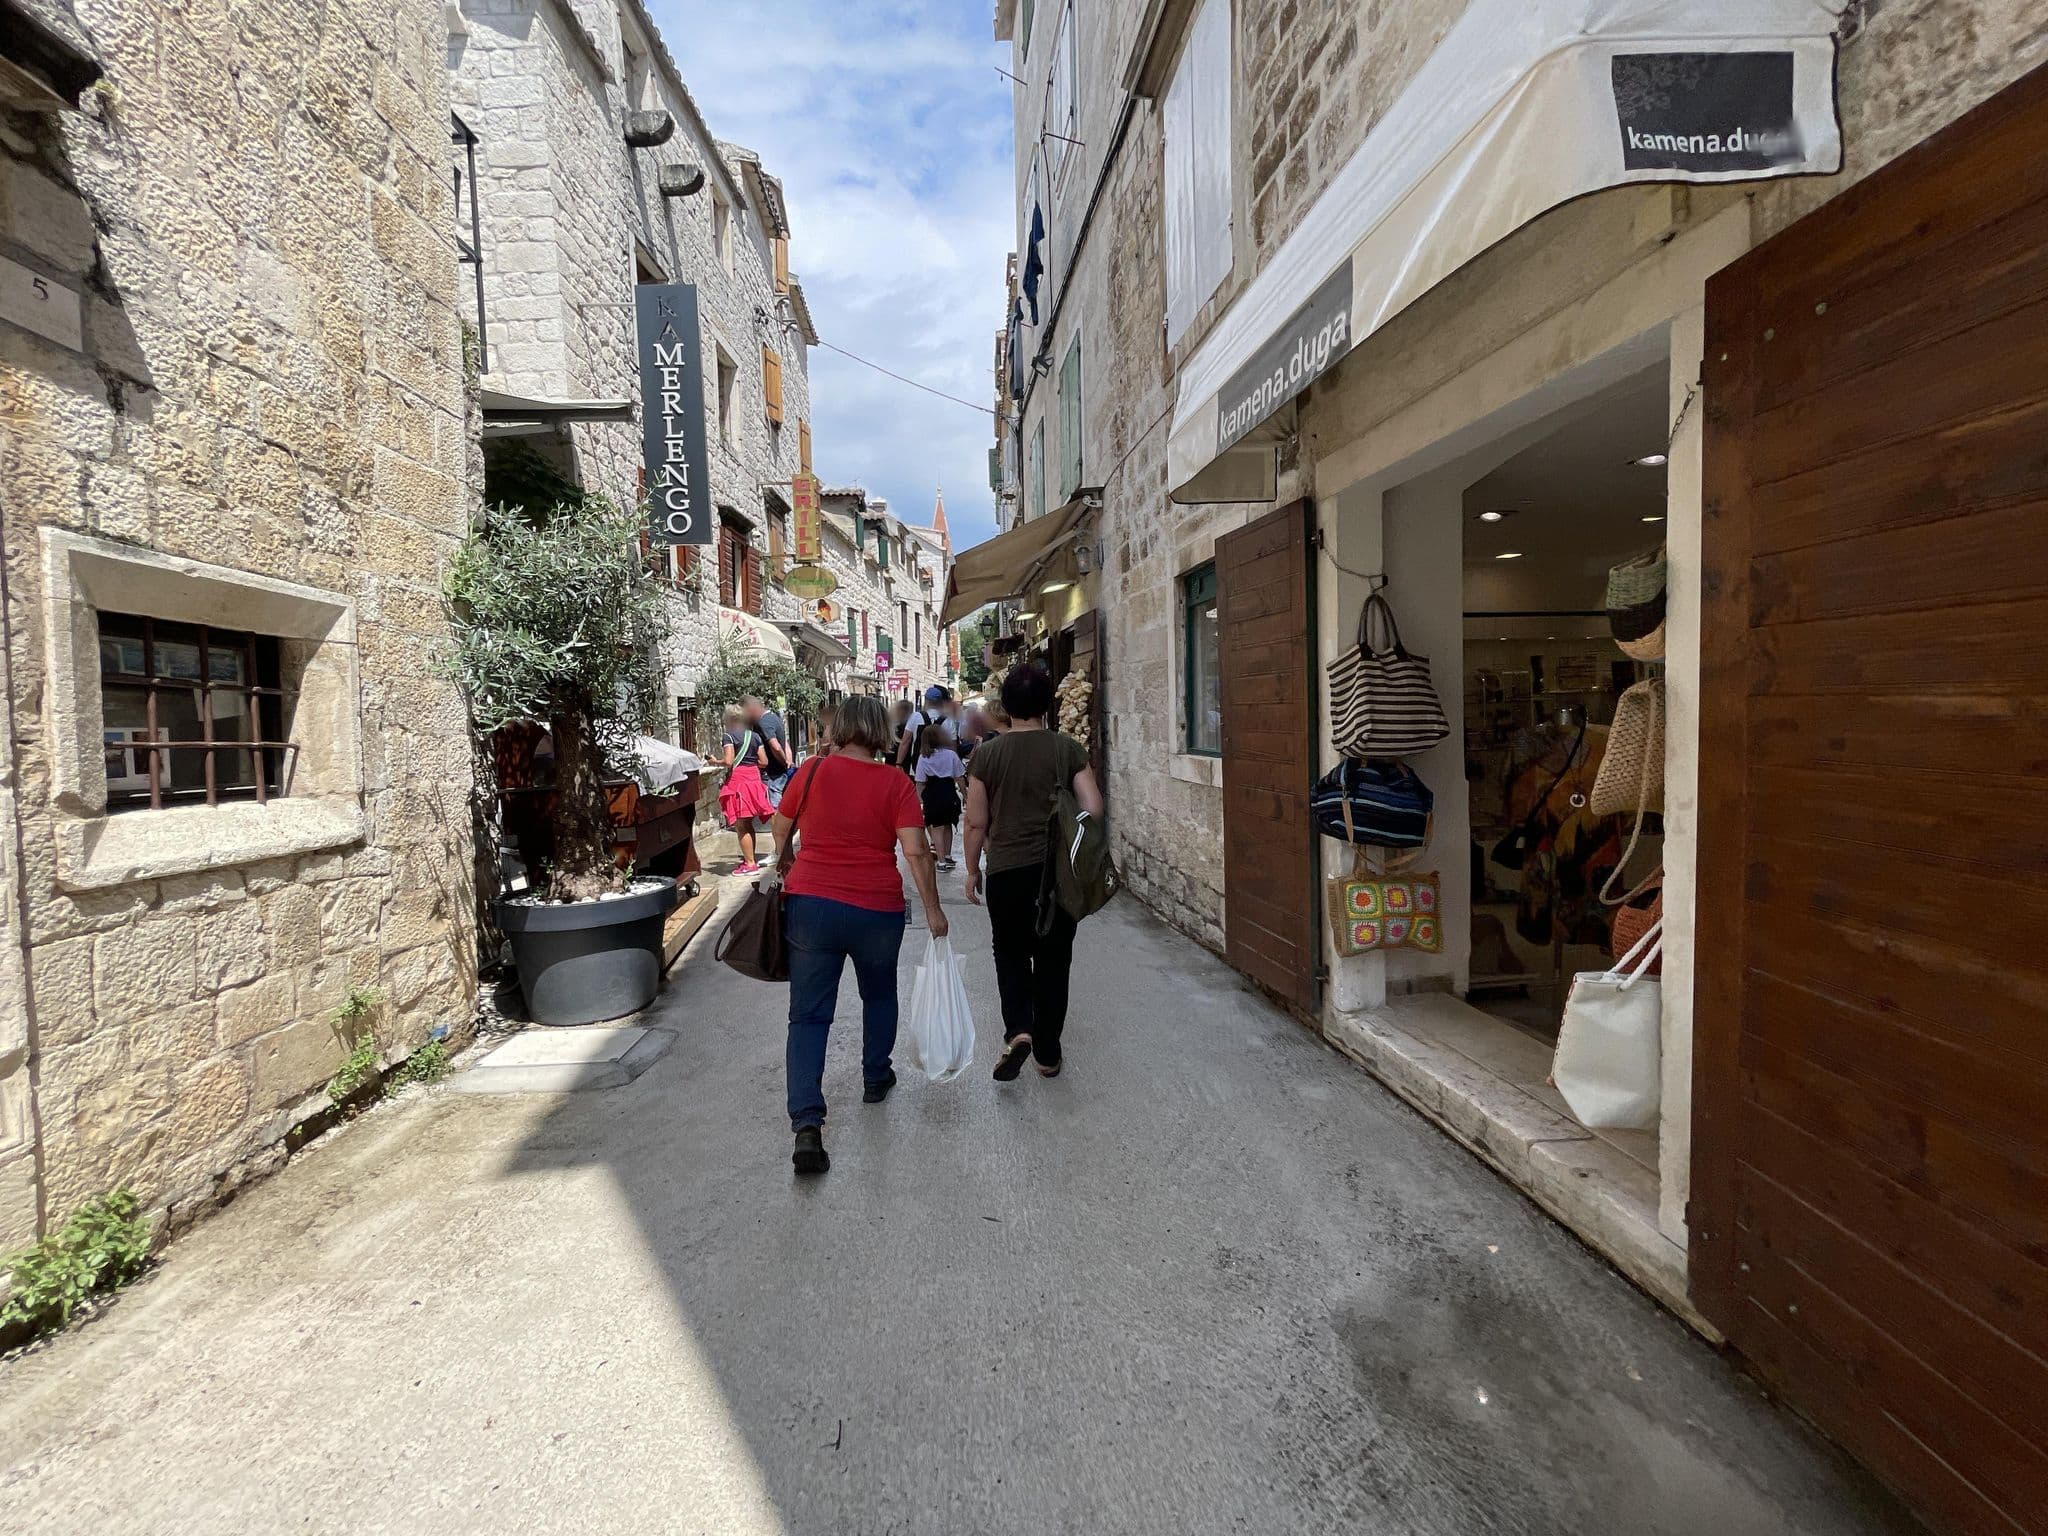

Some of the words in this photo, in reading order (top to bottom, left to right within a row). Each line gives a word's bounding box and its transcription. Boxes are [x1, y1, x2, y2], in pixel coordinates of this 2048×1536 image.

[32, 277, 49, 300] 5
[1219, 311, 1347, 443] kamena.duga
[795, 479, 813, 556] GRILL
